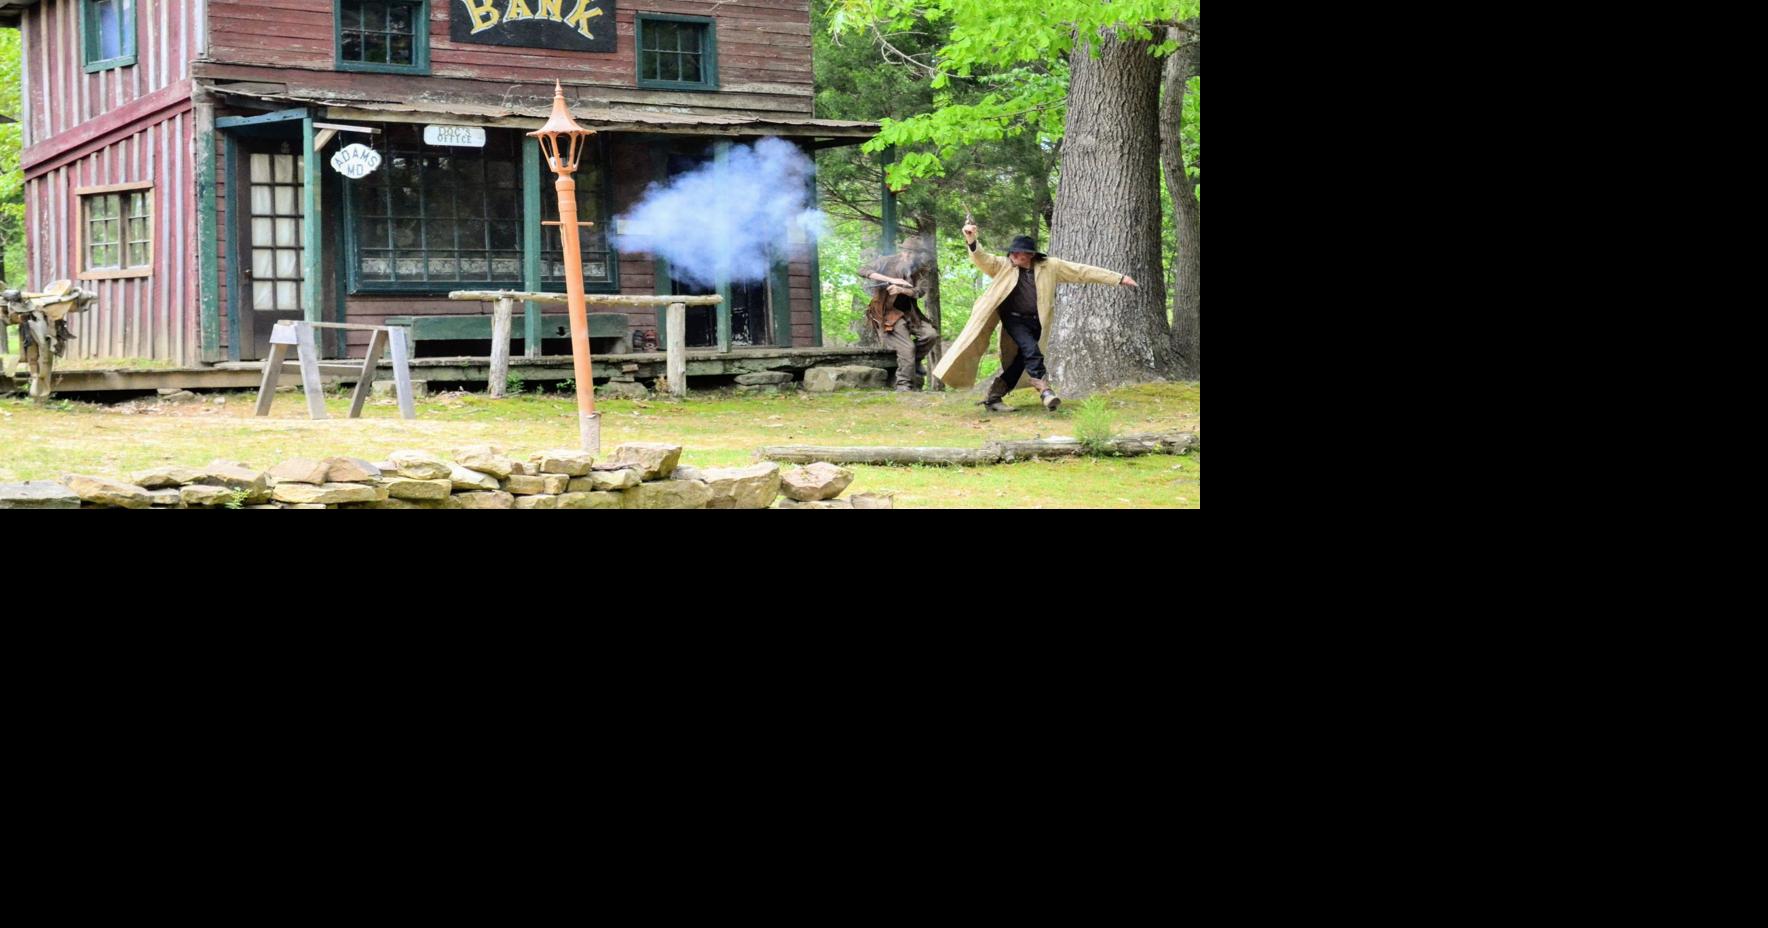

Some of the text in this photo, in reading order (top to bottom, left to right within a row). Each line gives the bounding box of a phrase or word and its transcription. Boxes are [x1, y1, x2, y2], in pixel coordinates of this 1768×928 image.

[461, 0, 603, 40] BANK
[437, 134, 472, 145] OFFICE
[334, 147, 378, 168] ADAMS
[347, 163, 364, 177] MD
